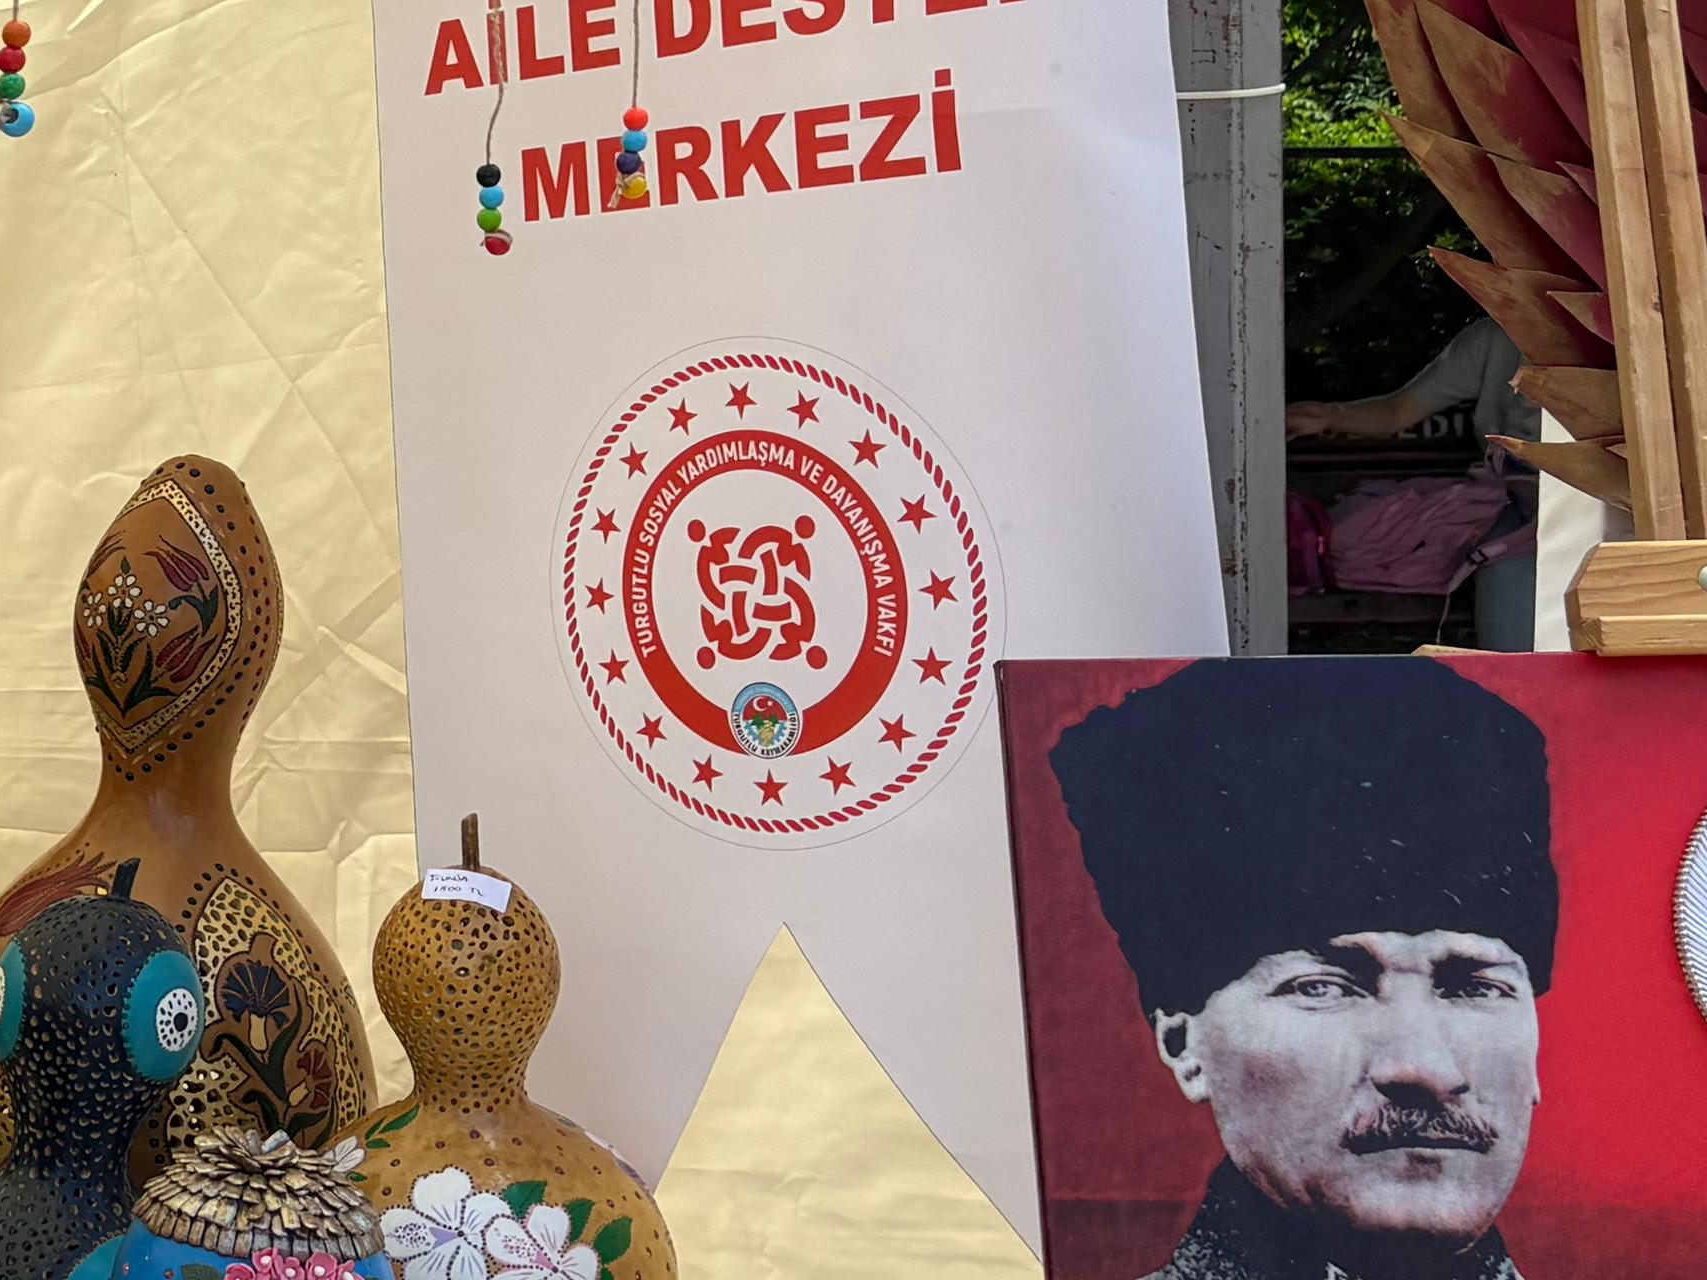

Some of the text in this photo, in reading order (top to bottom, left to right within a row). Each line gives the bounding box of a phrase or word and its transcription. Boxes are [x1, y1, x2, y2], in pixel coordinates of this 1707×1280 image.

[521, 68, 962, 222] MERKEZİ
[631, 440, 897, 658] TURGUTLU SOSYAL YARDIMLAŞMA VE DAYANIŞMA VAKFI
